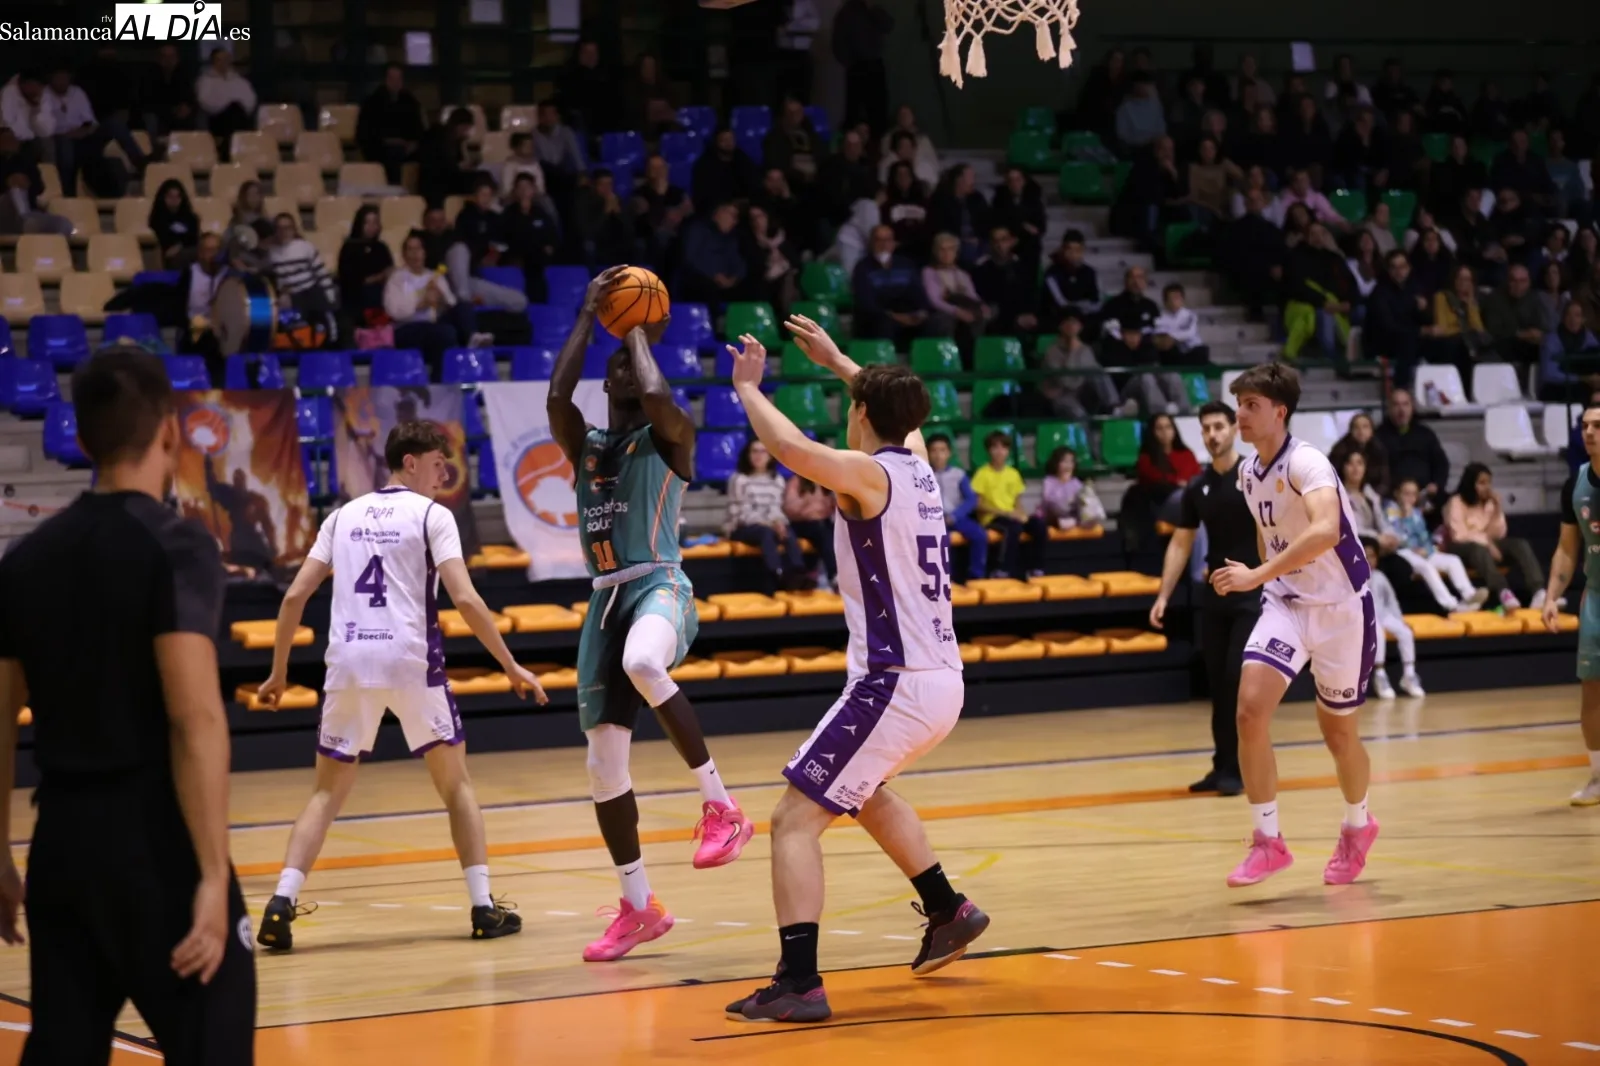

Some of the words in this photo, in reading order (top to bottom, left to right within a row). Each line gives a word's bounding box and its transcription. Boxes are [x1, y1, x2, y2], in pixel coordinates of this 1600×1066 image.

[1258, 501, 1276, 528] 17
[592, 540, 617, 572] 11
[354, 554, 387, 607] 4
[357, 632, 394, 641] Boecillo
[805, 759, 829, 782] CBC
